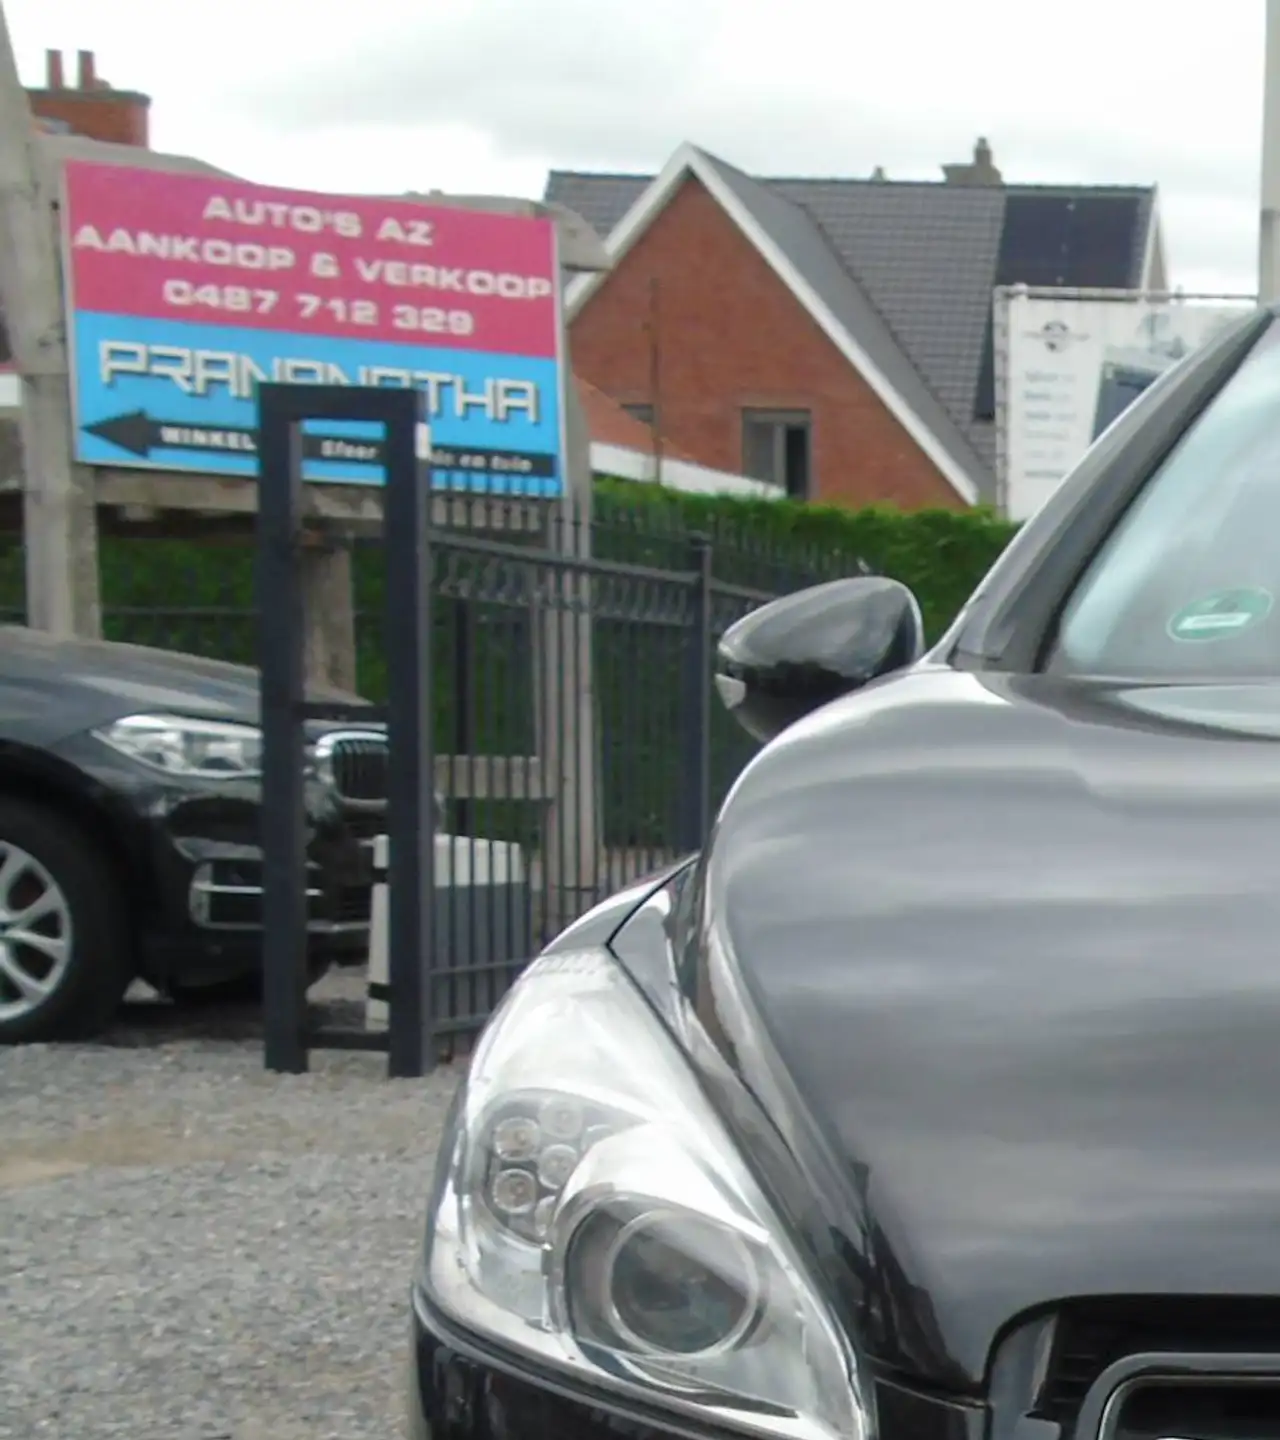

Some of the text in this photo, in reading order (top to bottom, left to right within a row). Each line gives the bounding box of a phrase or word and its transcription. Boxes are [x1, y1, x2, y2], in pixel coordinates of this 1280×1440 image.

[203, 197, 434, 246] AUTO'S AZ
[74, 224, 552, 300] AANKOOP & VERKOOP
[163, 279, 474, 336] 0487 712 329
[161, 425, 257, 451] WINKEL
